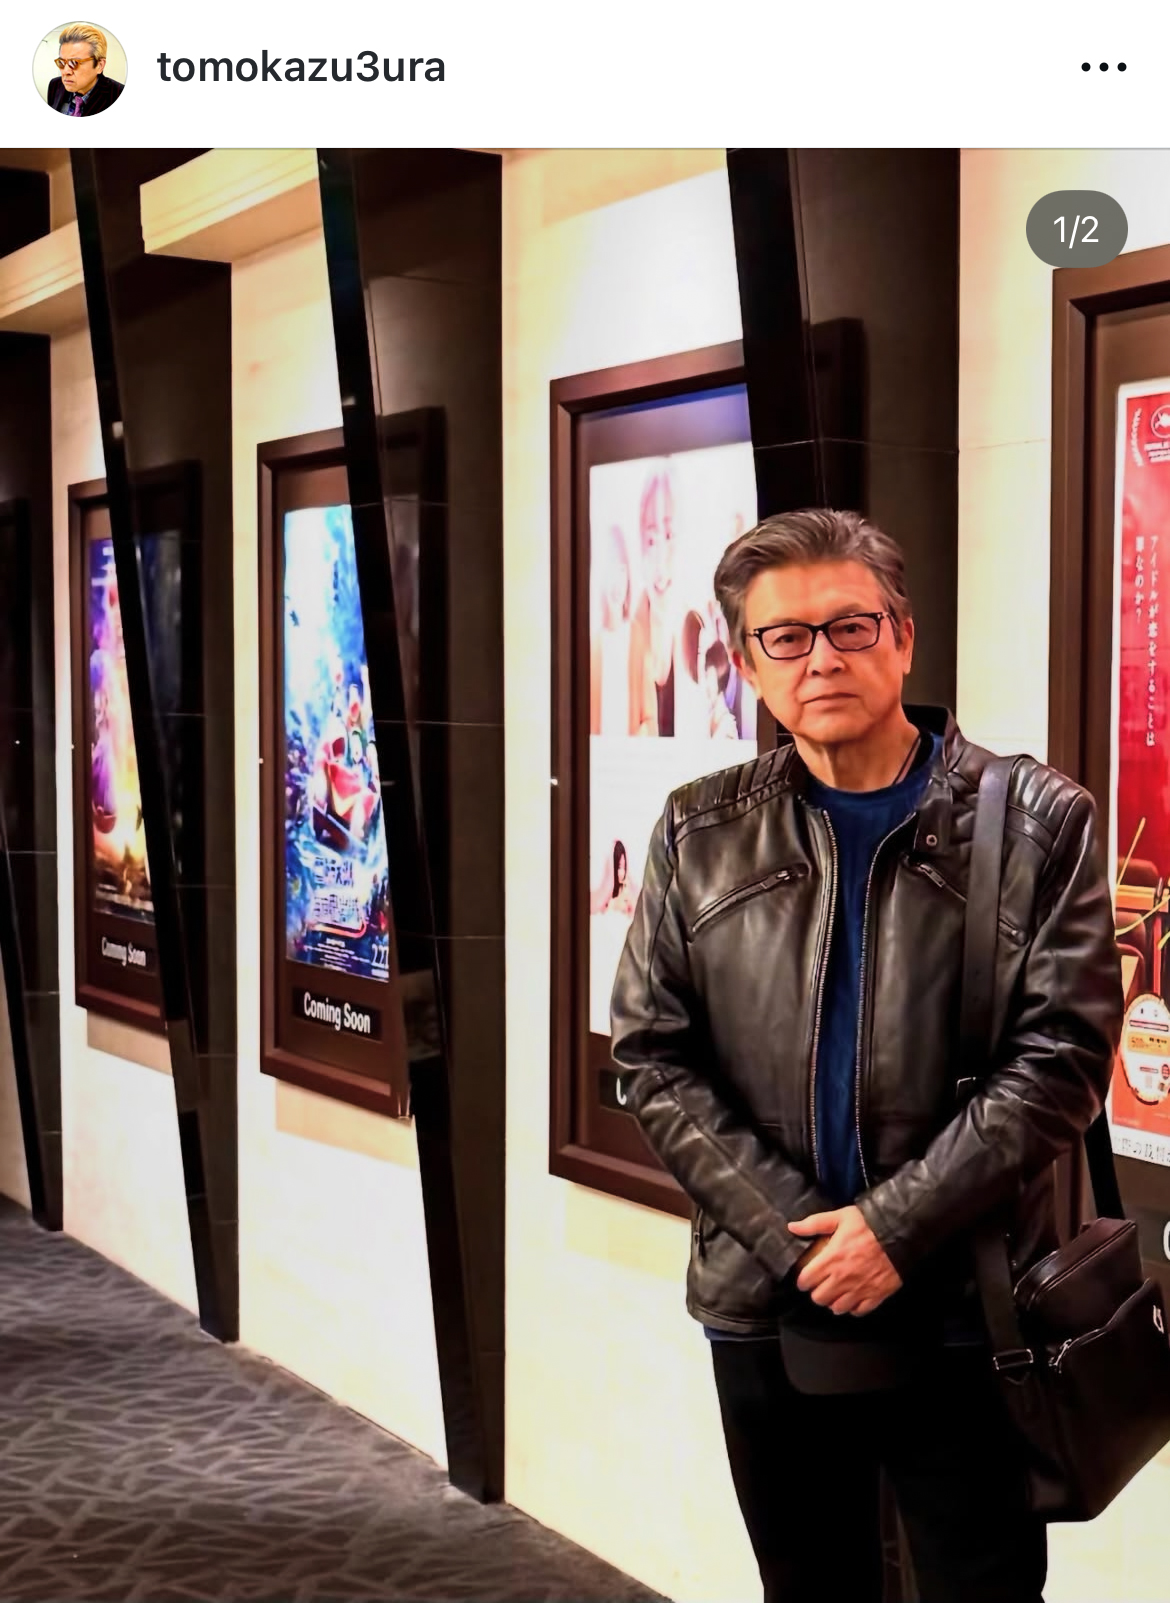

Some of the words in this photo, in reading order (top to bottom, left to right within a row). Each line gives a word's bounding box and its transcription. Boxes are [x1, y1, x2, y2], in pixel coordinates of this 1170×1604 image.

[128, 942, 147, 968] Soon
[303, 991, 342, 1032] Coming
[343, 1002, 371, 1034] Soon
